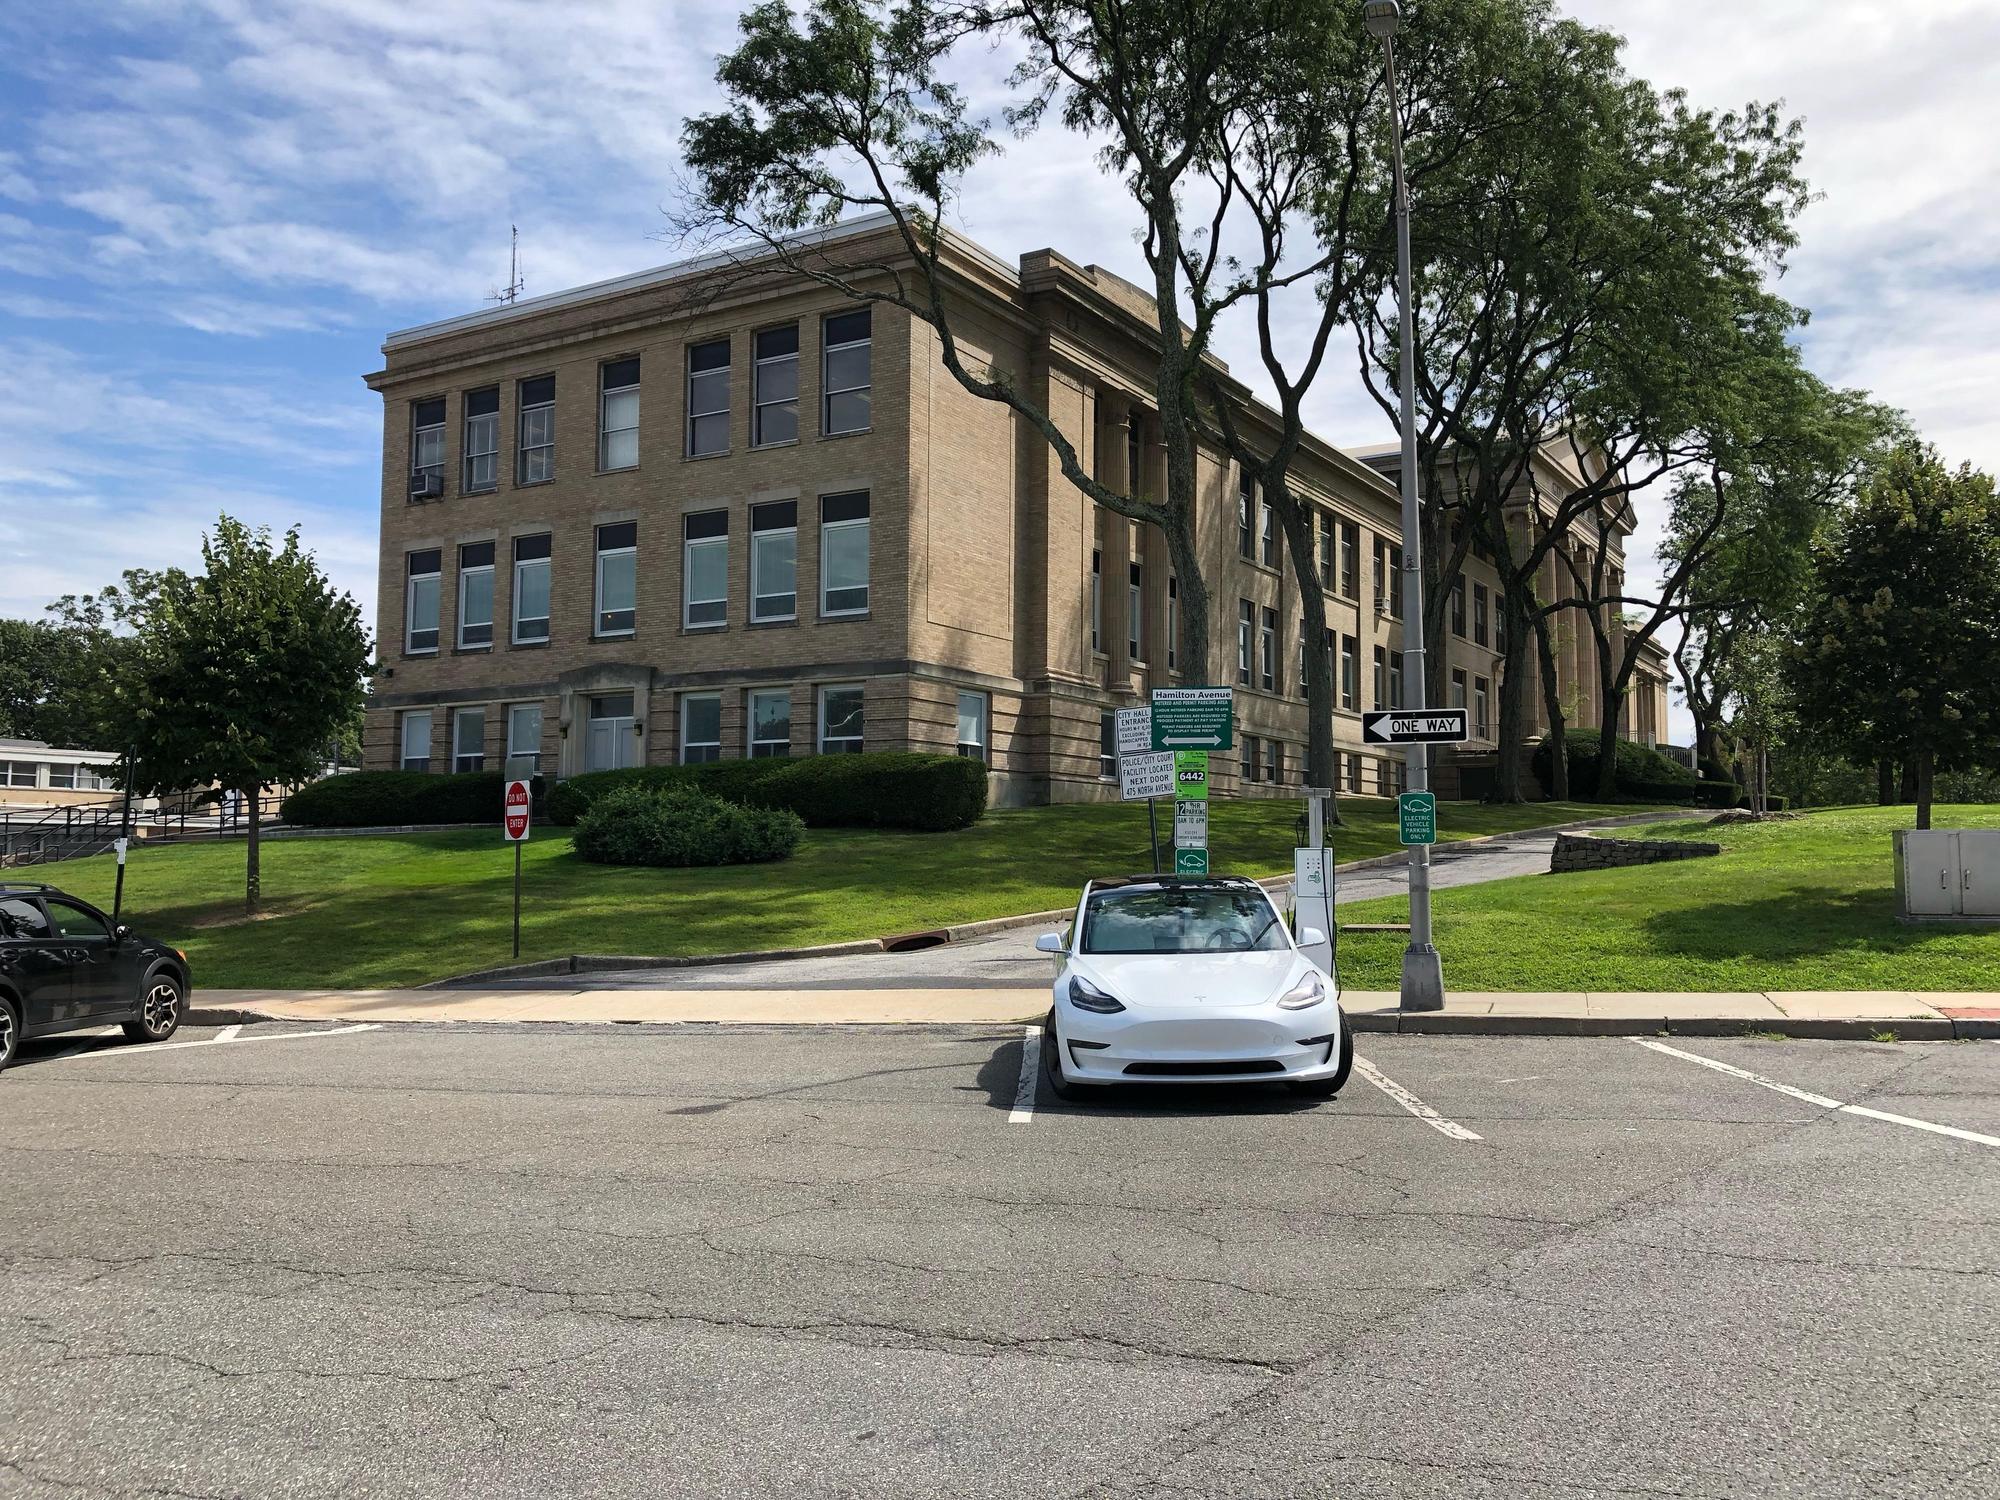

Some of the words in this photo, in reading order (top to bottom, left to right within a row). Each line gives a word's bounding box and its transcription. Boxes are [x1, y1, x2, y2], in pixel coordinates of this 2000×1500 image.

[1118, 711, 1130, 719] CITY
[1392, 720, 1419, 733] ONE
[1427, 719, 1456, 732] WAY
[1122, 755, 1155, 766] POLICE/CITY
[1157, 753, 1173, 762] COURT
[1123, 767, 1146, 776] FACILITY
[1149, 764, 1173, 774] LOCATED
[1130, 777, 1147, 785] NEXT
[1150, 774, 1169, 783] DOOR
[1180, 772, 1204, 780] 6442
[1127, 788, 1136, 796] 475
[1138, 786, 1154, 794] NORTH
[1156, 782, 1174, 792] AVENUE
[508, 794, 515, 802] DO
[517, 793, 526, 802] NOT
[1177, 803, 1185, 815] 12
[510, 819, 523, 828] ENTER
